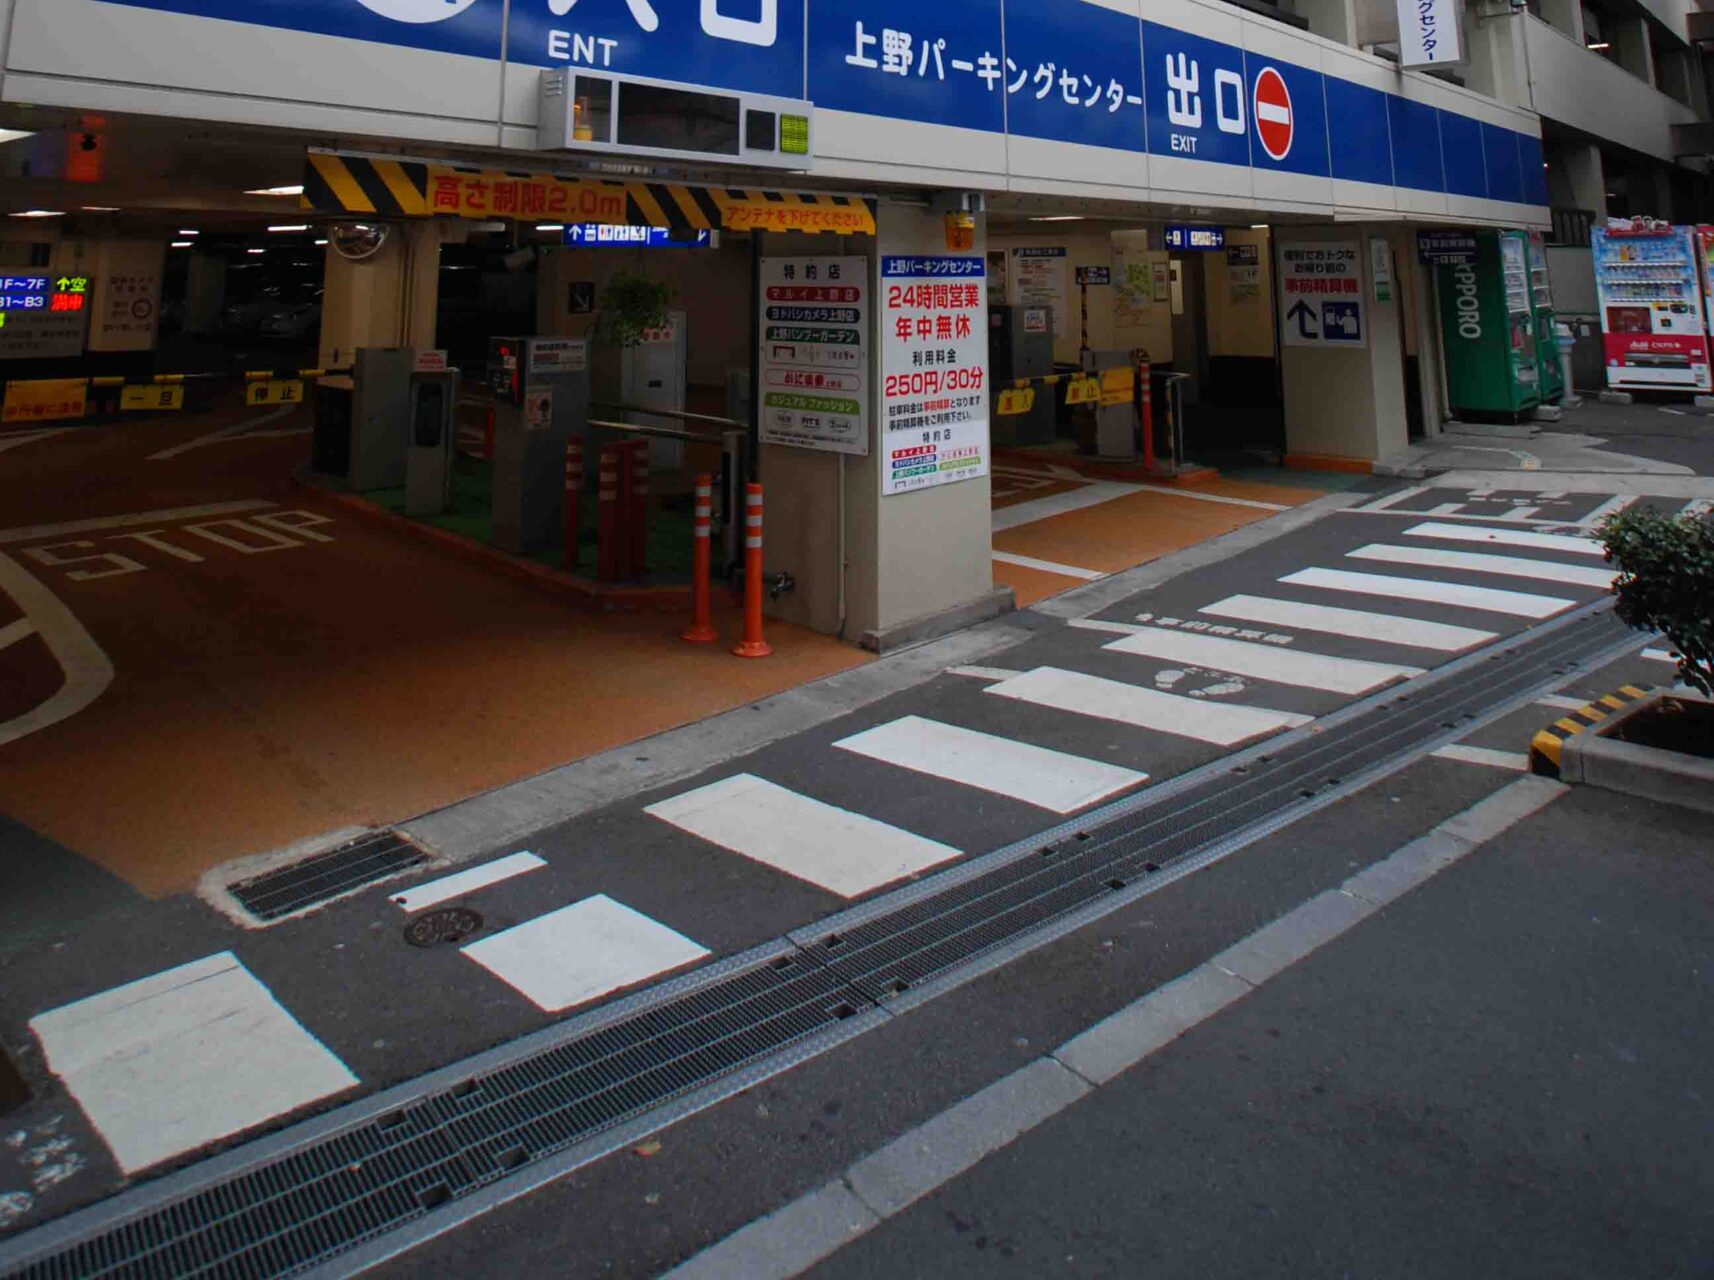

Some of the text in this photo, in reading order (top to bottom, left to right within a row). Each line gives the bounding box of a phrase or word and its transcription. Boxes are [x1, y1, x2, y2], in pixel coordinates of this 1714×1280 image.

[547, 29, 619, 67] ENT
[845, 20, 1143, 114] 上野パーキングセンター
[1165, 51, 1247, 135] 出口
[1170, 133, 1199, 154] EXIT
[433, 175, 624, 215] 高さ制限2.0m
[726, 206, 864, 228] アンテナを下げてください
[784, 263, 841, 280] 特約店
[887, 259, 982, 275] 上野パーキングセンター
[69, 277, 87, 292] 空
[888, 283, 980, 310] 24時間営業
[1453, 263, 1483, 340] PPORO
[895, 313, 972, 343] 年中無休
[912, 348, 957, 367] 利用料金
[885, 366, 984, 398] 250円/30分
[20, 508, 338, 582] STOP
